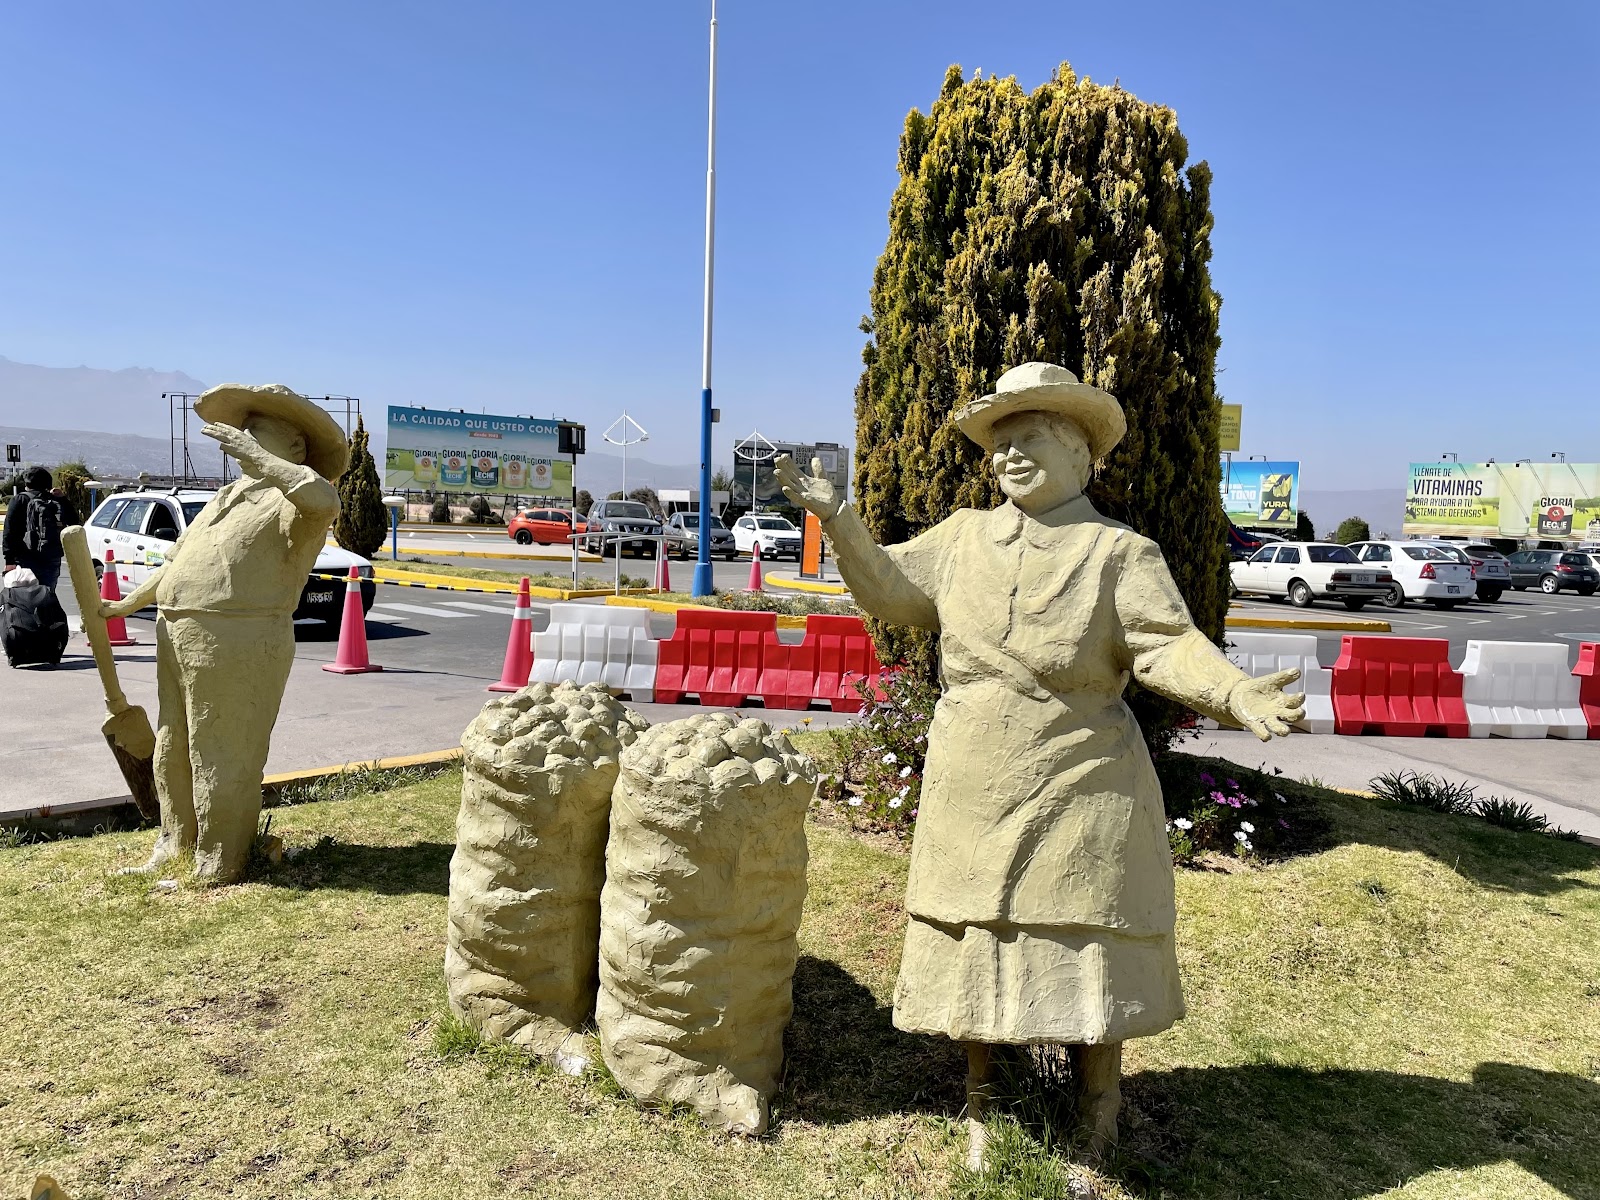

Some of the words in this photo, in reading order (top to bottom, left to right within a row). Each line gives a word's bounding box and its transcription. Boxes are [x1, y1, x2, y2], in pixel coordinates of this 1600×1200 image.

[393, 412, 407, 422] LA
[412, 414, 460, 427] CALIDAD
[464, 419, 488, 429] QUE
[492, 422, 525, 432] USTED
[415, 450, 437, 459] GLORIA
[442, 450, 466, 459] GLORIA
[472, 449, 498, 460] GLORIA
[502, 454, 526, 464] GLORIA
[530, 458, 552, 467] GLORIA
[1414, 466, 1441, 476] LLÉNATE
[1443, 468, 1452, 477] DE
[1414, 479, 1483, 496] VITAMINAS
[1412, 497, 1428, 506] PARA
[1430, 498, 1456, 507] AYUDAR
[1458, 499, 1463, 507] A
[1464, 499, 1472, 507] TU
[1540, 497, 1572, 508] GLORIA
[1439, 508, 1447, 517] DE
[1448, 509, 1482, 518] DEFENSAS
